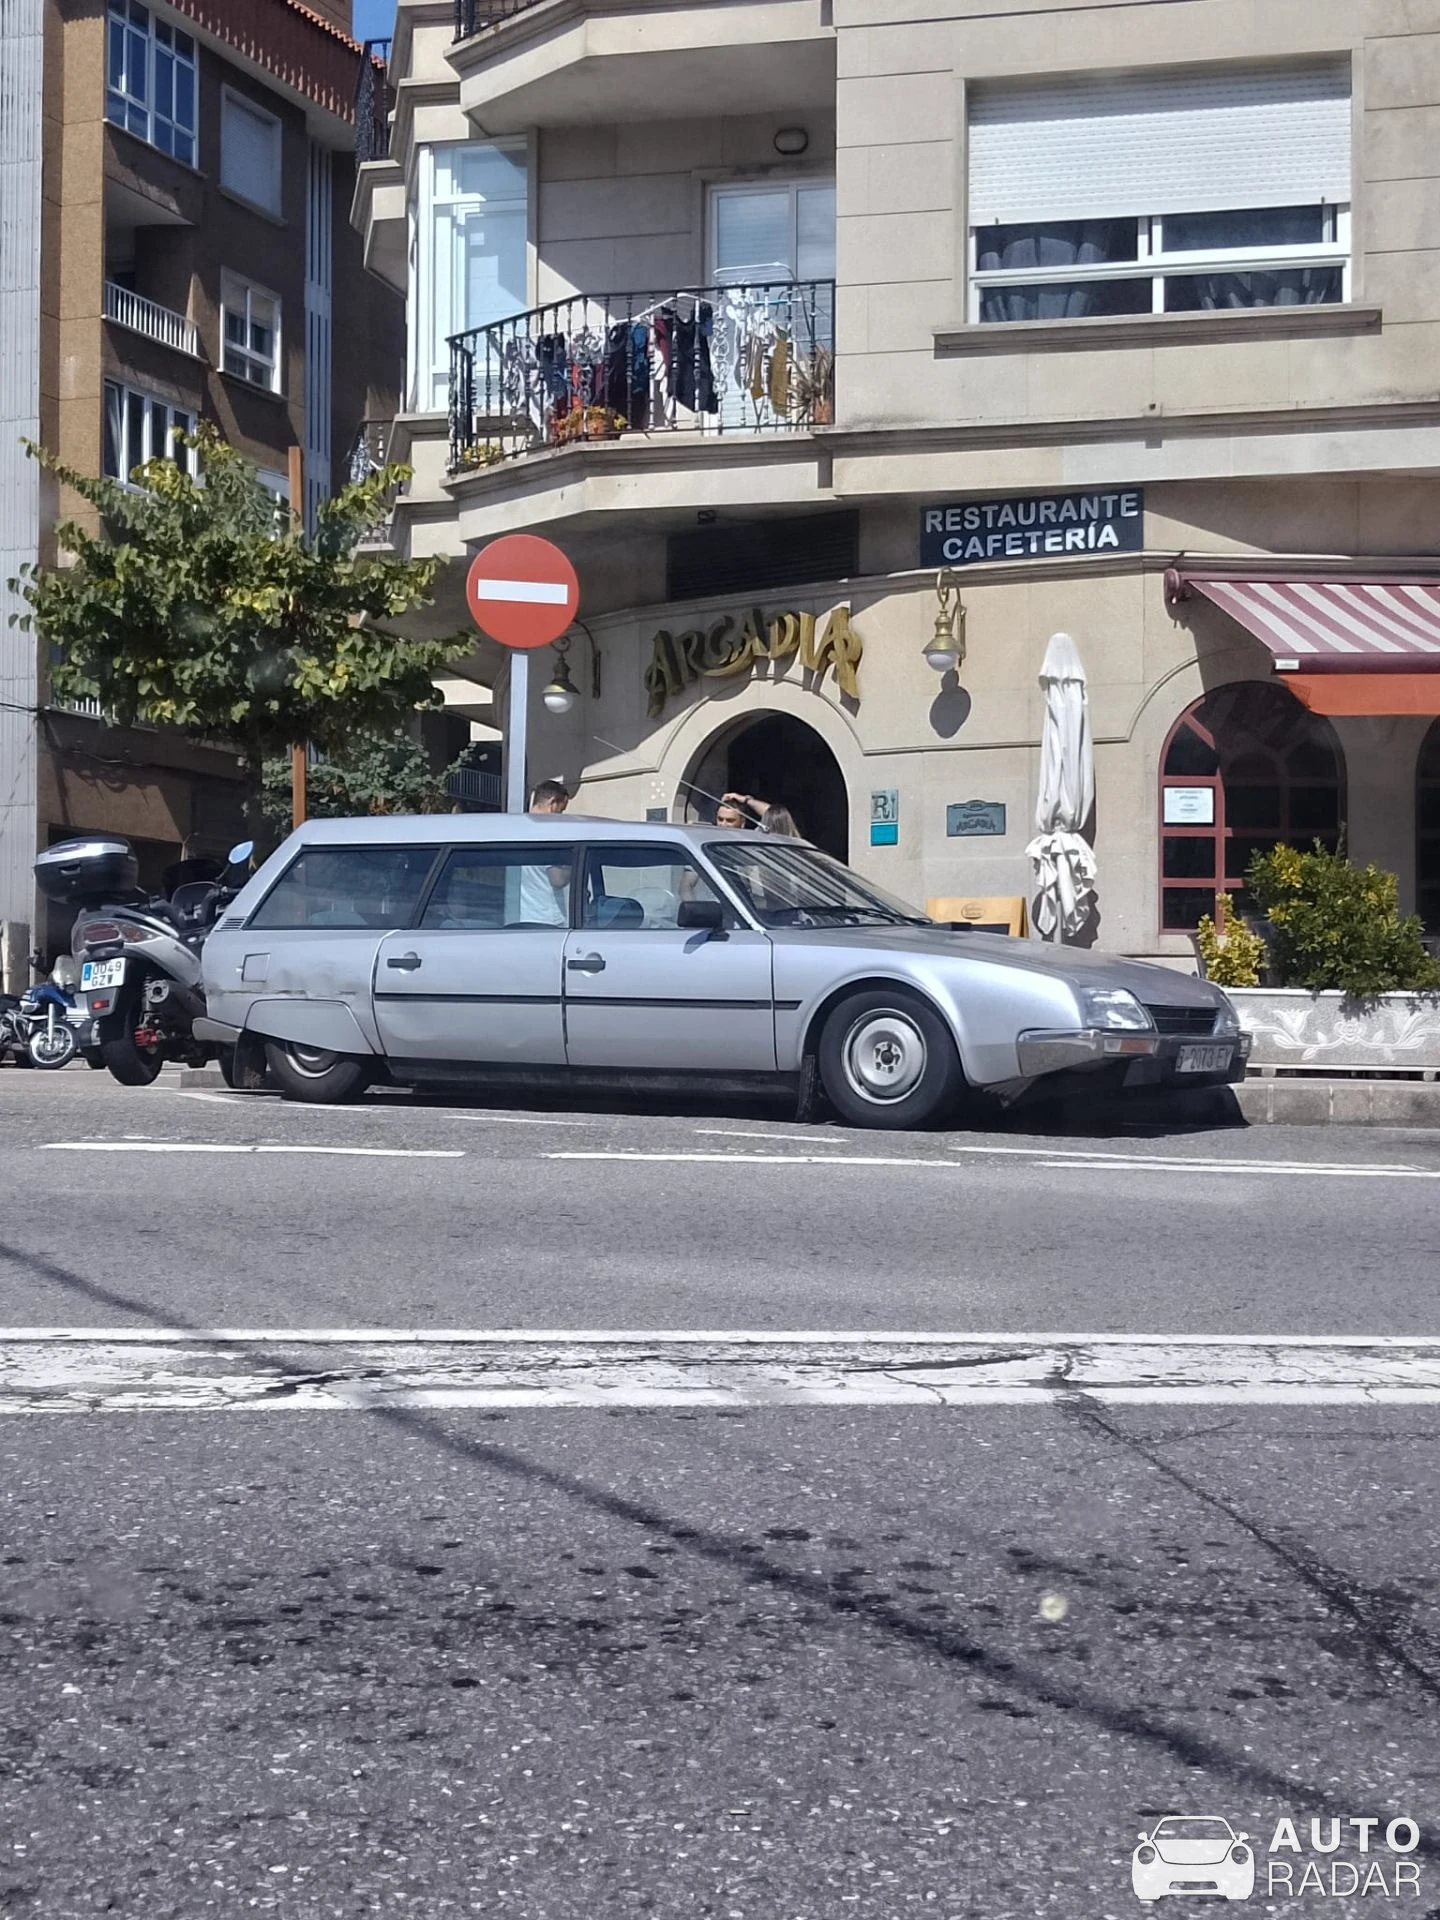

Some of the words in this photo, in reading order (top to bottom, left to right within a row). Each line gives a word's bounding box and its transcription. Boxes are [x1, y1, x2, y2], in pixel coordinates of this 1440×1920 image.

[925, 493, 1139, 533] RESTAURANTE
[942, 521, 1120, 560] CAFETERÍA
[644, 606, 863, 719] ARCADIA
